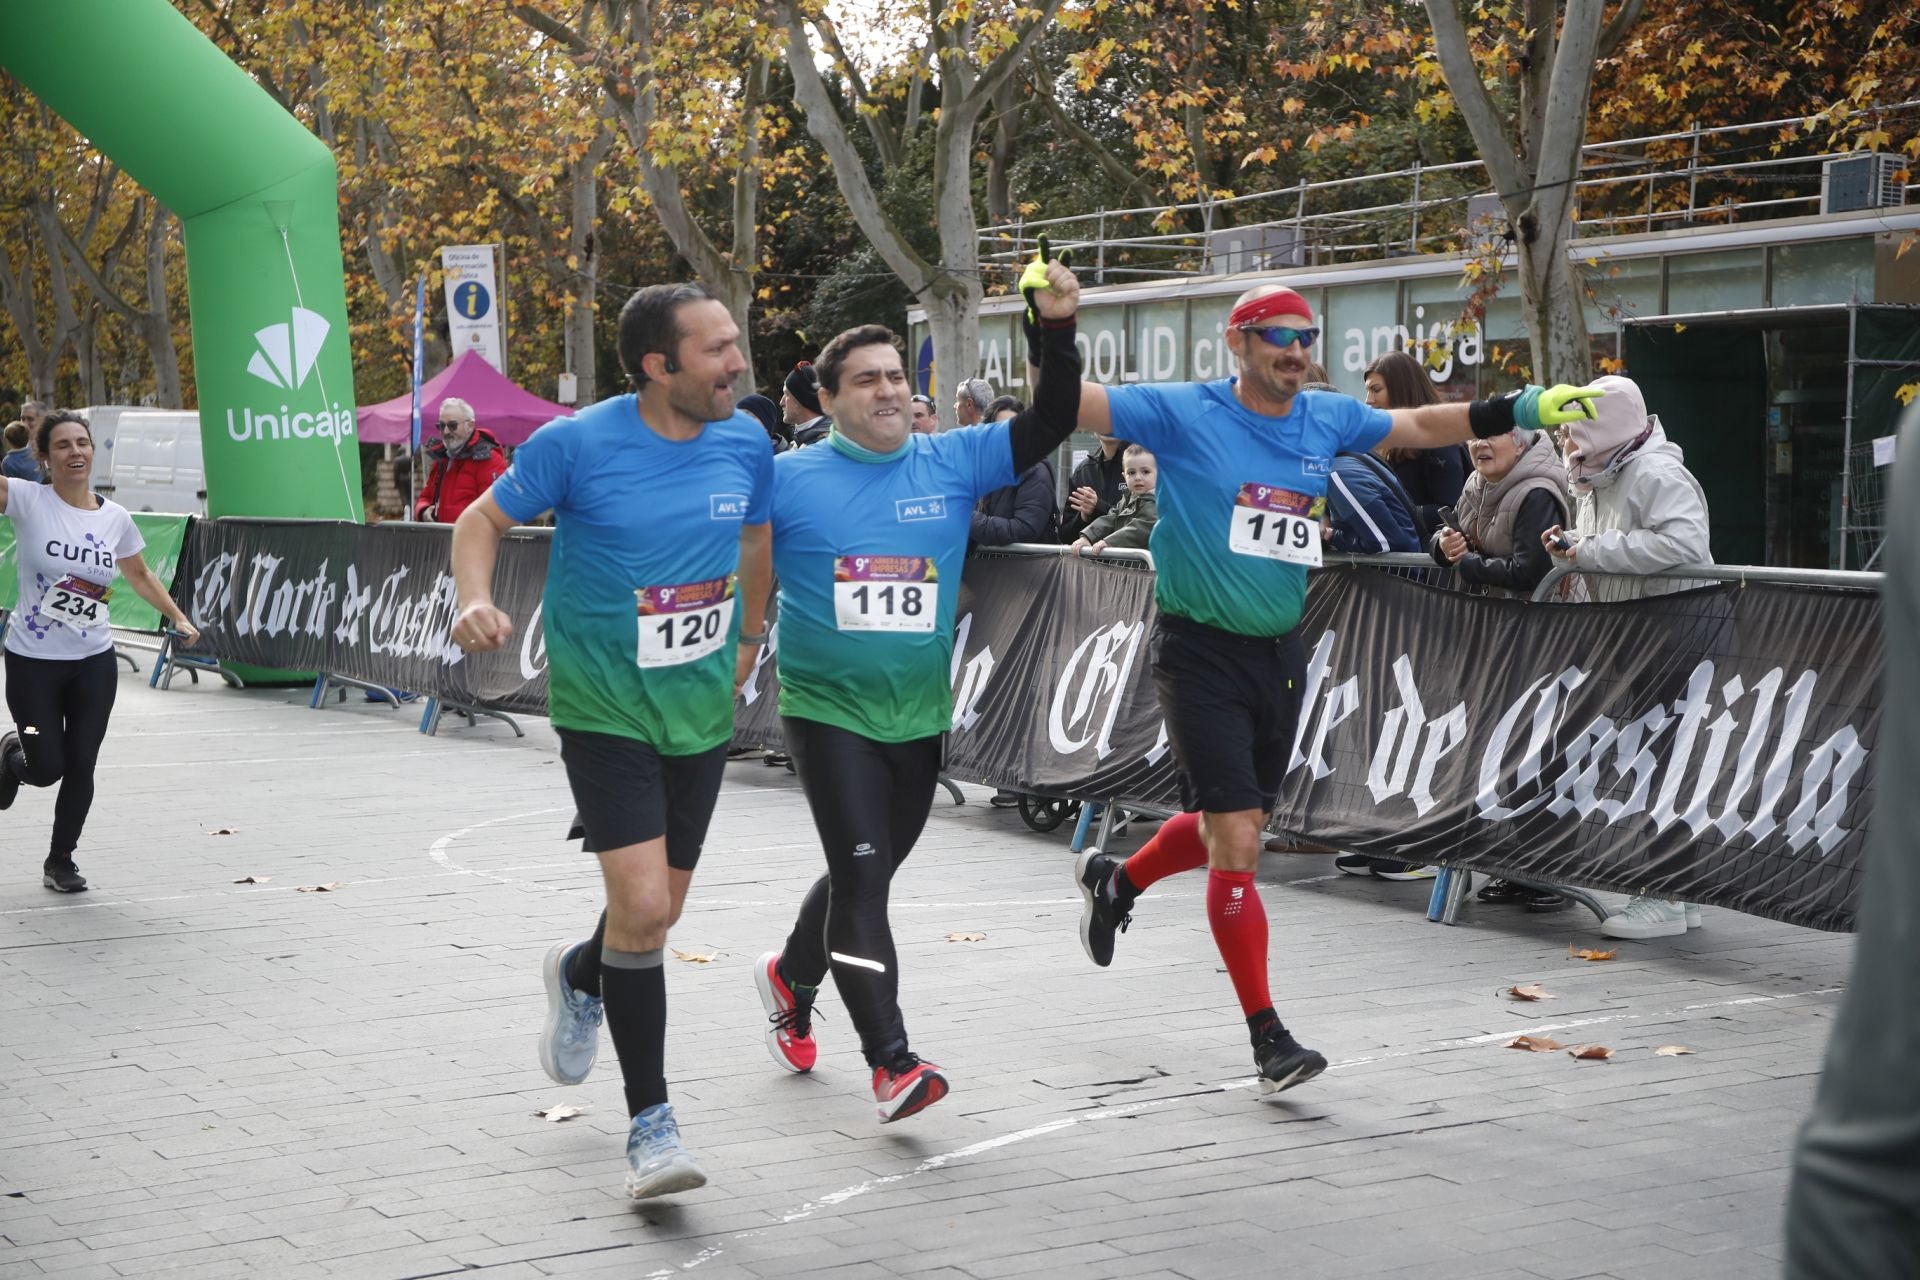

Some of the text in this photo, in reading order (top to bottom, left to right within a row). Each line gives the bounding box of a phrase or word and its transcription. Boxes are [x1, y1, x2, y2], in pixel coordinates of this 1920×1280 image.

[978, 326, 1177, 389] ALDOLID
[1343, 306, 1485, 383] amiga
[226, 402, 353, 447] Unicaja
[1307, 462, 1326, 471] AVL
[718, 503, 738, 513] AVL
[904, 505, 928, 516] AVL
[1247, 513, 1309, 549] 119
[45, 540, 113, 568] curia
[87, 567, 113, 578] SPAIN
[51, 591, 98, 621] 234
[192, 552, 239, 634] El
[236, 552, 336, 640] Norte
[334, 563, 371, 648] de
[852, 585, 922, 616] 118
[656, 608, 720, 650] 120
[1049, 620, 1145, 761] El
[1365, 653, 1467, 819] de
[1475, 659, 1869, 857] Castilla
